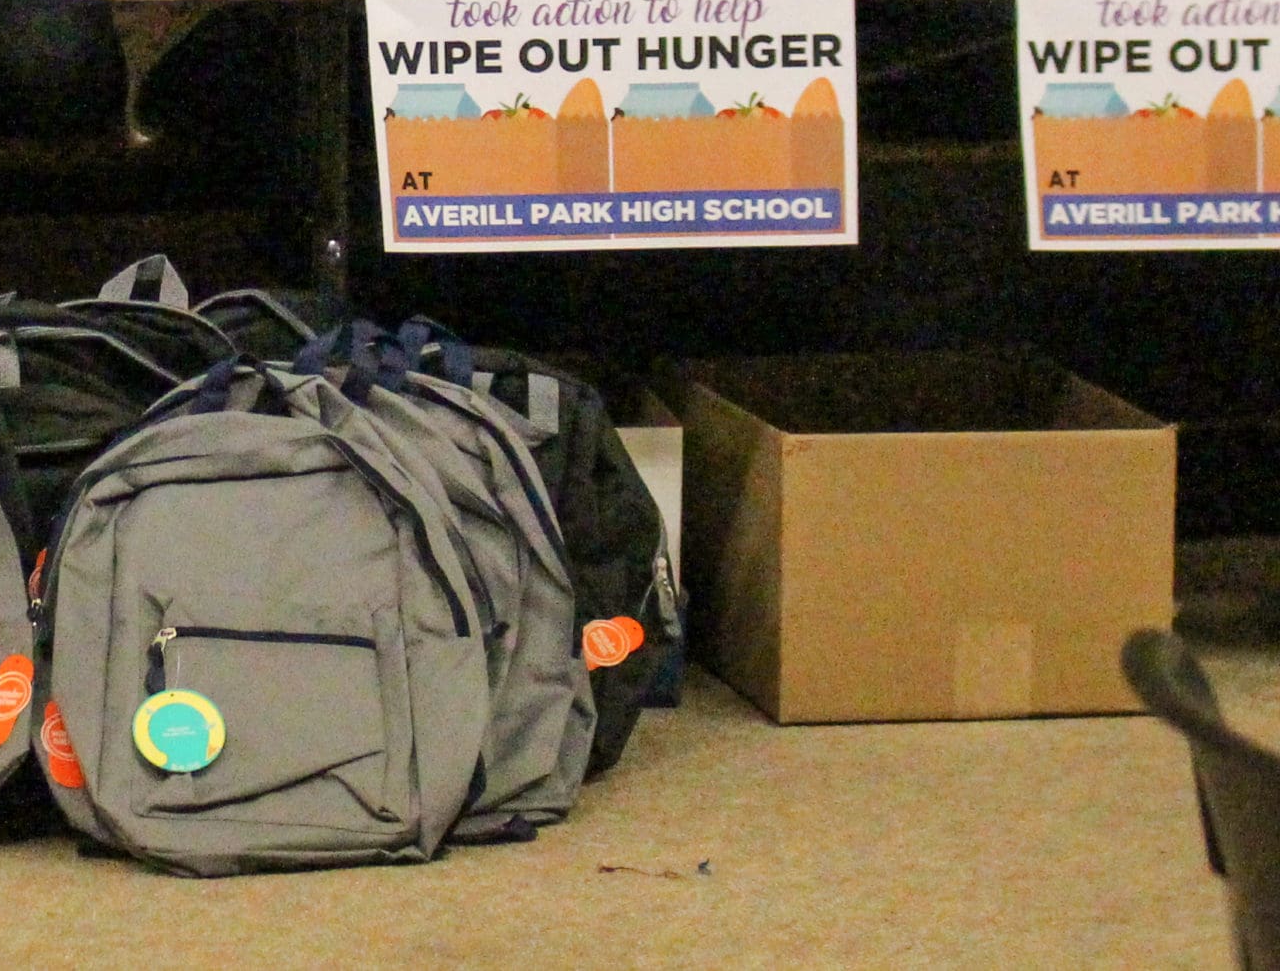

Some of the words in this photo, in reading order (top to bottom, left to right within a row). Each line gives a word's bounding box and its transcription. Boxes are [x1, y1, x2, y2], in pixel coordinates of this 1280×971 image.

[378, 40, 503, 75] WIPE
[519, 38, 620, 72] OUT
[637, 34, 843, 70] HUNGER
[1029, 39, 1152, 74] WIPE
[1169, 39, 1270, 72] OUT
[402, 170, 433, 191] AT
[1049, 170, 1080, 189] AT
[403, 203, 523, 227] AVERILL
[531, 201, 614, 225] PARK
[621, 200, 697, 223] HIGH
[703, 197, 832, 220] SCHOOL
[1049, 201, 1171, 225] AVERILL
[1177, 200, 1263, 224] PARK
